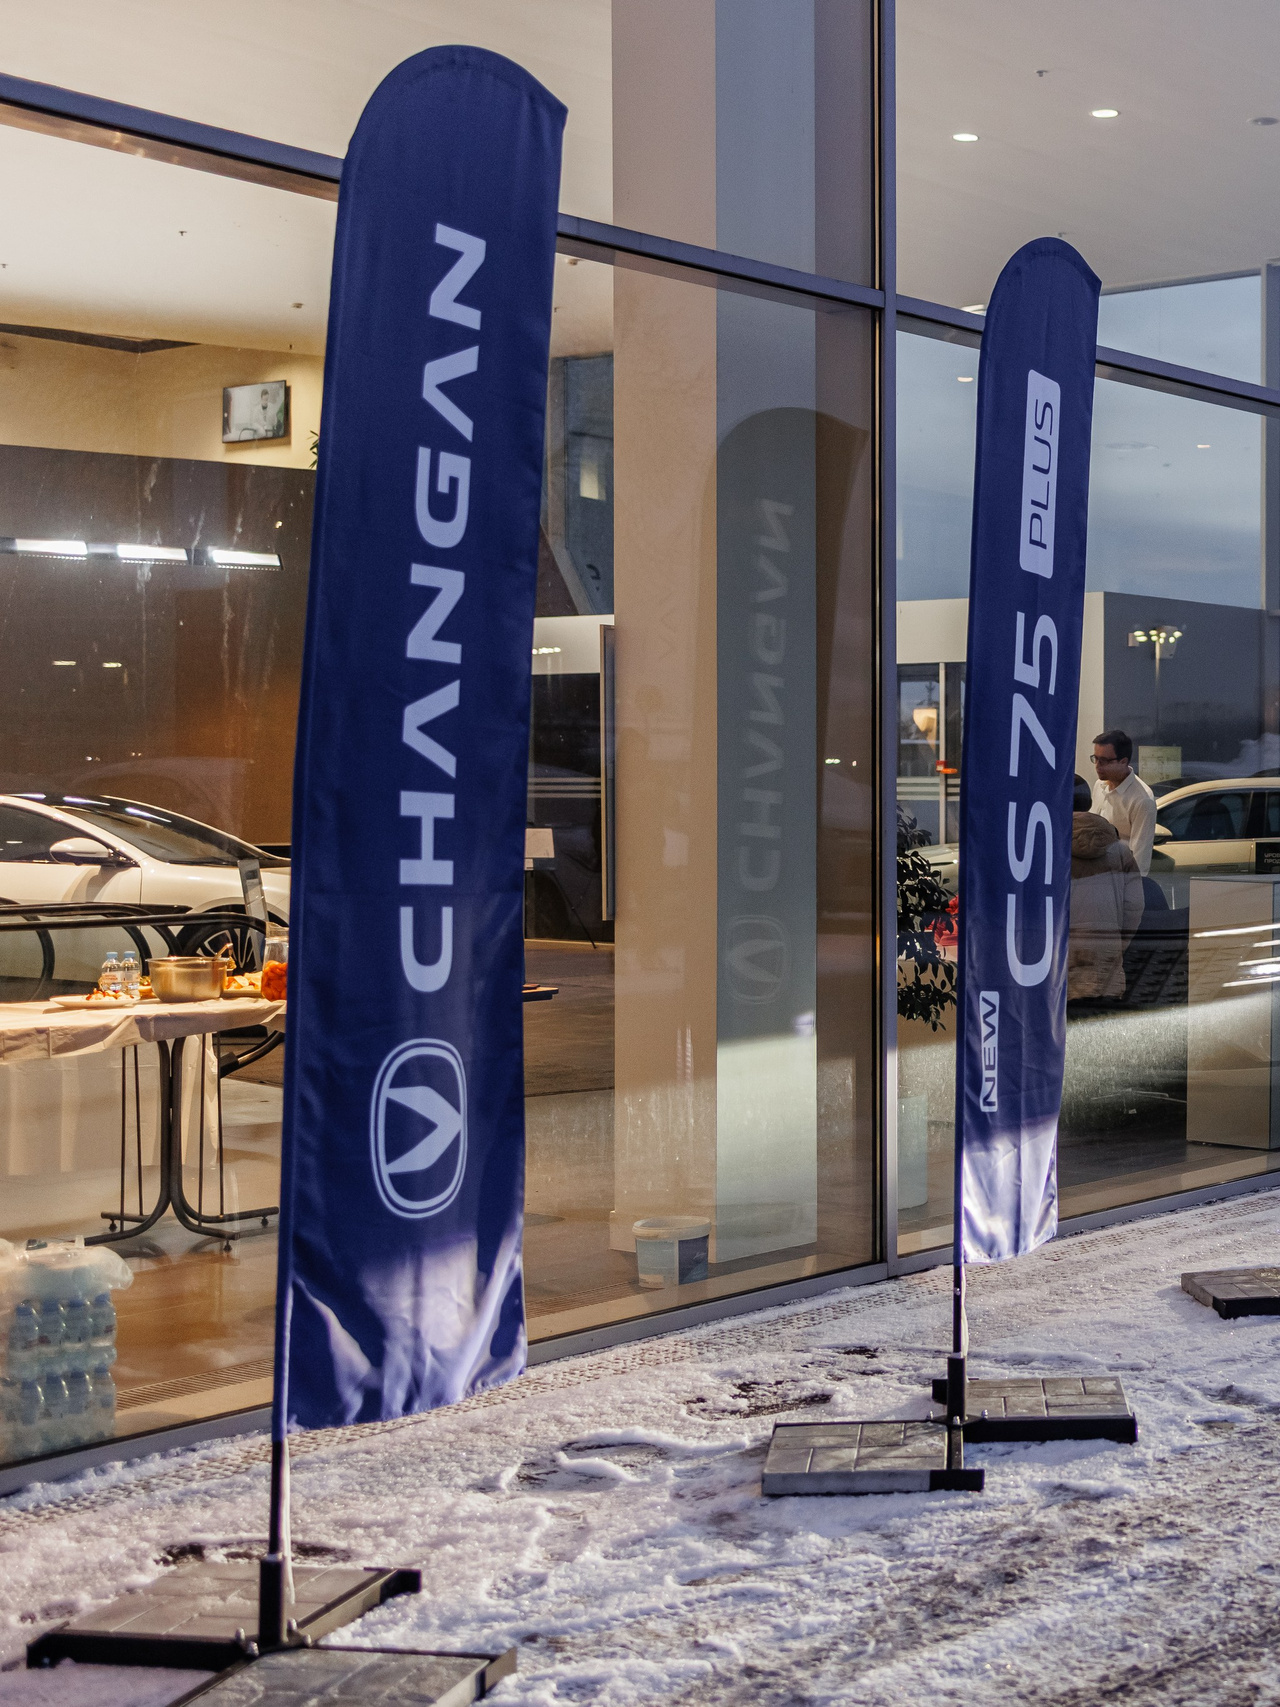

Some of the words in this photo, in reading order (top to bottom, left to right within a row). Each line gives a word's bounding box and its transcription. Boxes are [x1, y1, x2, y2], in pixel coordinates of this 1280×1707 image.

[1028, 397, 1054, 550] PLUS
[399, 223, 488, 994] CHANGAN
[1006, 611, 1059, 988] CS75
[981, 996, 997, 1107] NEW
